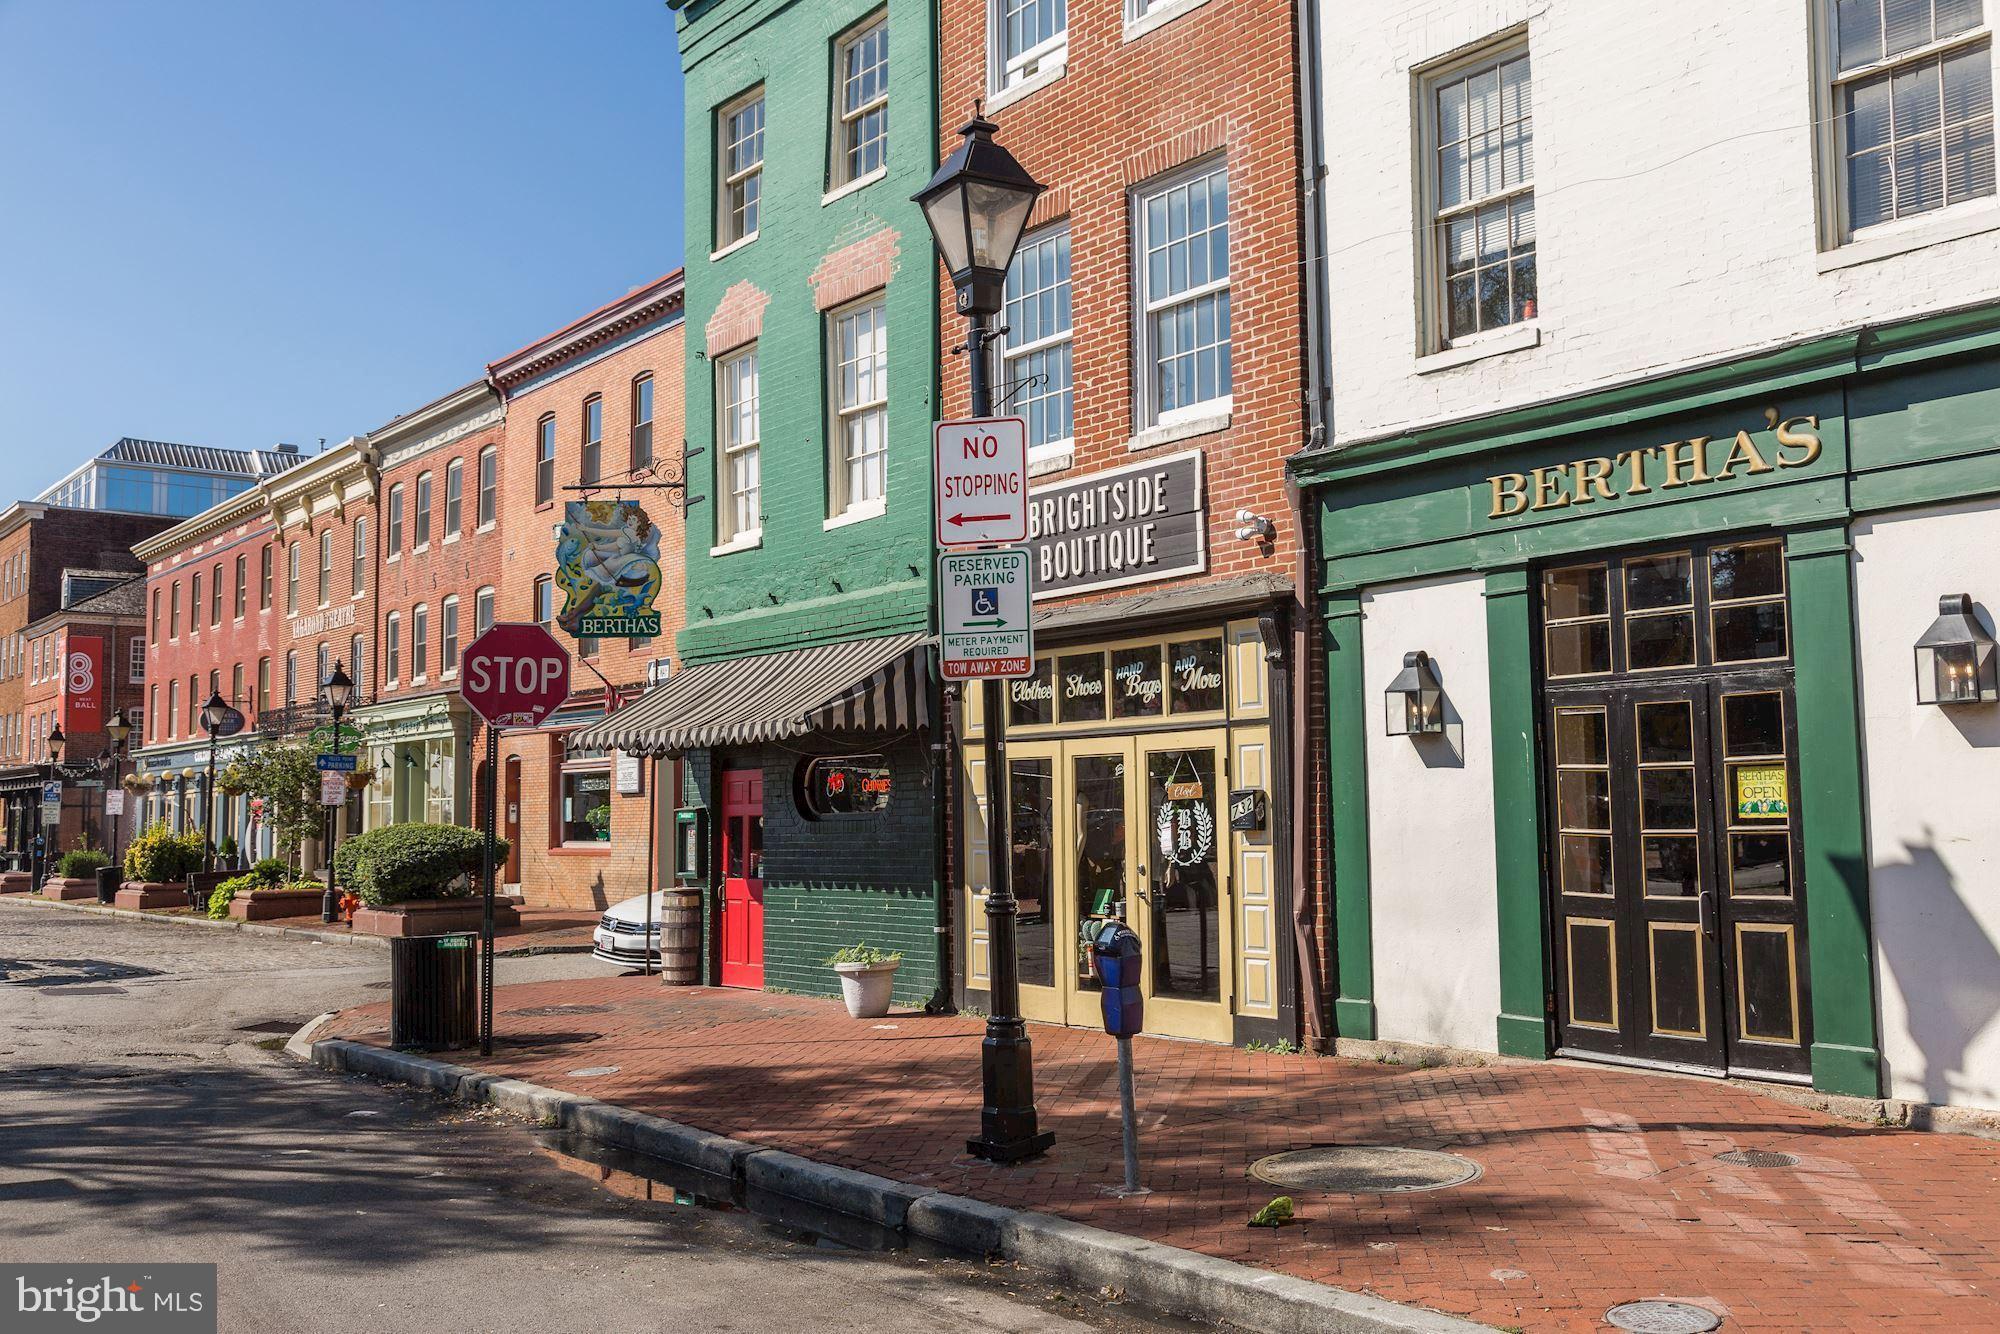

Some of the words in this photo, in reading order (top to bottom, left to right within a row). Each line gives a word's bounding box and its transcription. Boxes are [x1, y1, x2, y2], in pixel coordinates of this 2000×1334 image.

[963, 435, 998, 460] NO
[1486, 407, 1822, 519] BERTHA'S
[945, 472, 1019, 498] STOPPING
[1029, 471, 1168, 539] BRIGHTSIDE
[1040, 522, 1157, 582] BOUTIQUE
[949, 556, 1020, 572] RESERVED
[954, 571, 1015, 587] PARKING
[581, 617, 659, 634] BERTHA'S
[948, 636, 978, 647] METER
[980, 634, 1024, 645] PAYMENT
[963, 646, 1009, 657] REQUIRED
[469, 655, 563, 694] STOP
[948, 662, 968, 675] TOW
[969, 660, 999, 674] AWAY
[1001, 659, 1026, 673] ZONE
[1116, 661, 1144, 680] HAND
[1174, 655, 1197, 673] AND
[1066, 674, 1102, 699] Shoes
[1180, 665, 1222, 692] More
[1011, 679, 1052, 702] Clothes
[1126, 676, 1162, 704] Bags
[327, 761, 354, 769] PARKING
[1743, 786, 1782, 798] OPEN
[1232, 797, 1252, 819] 732
